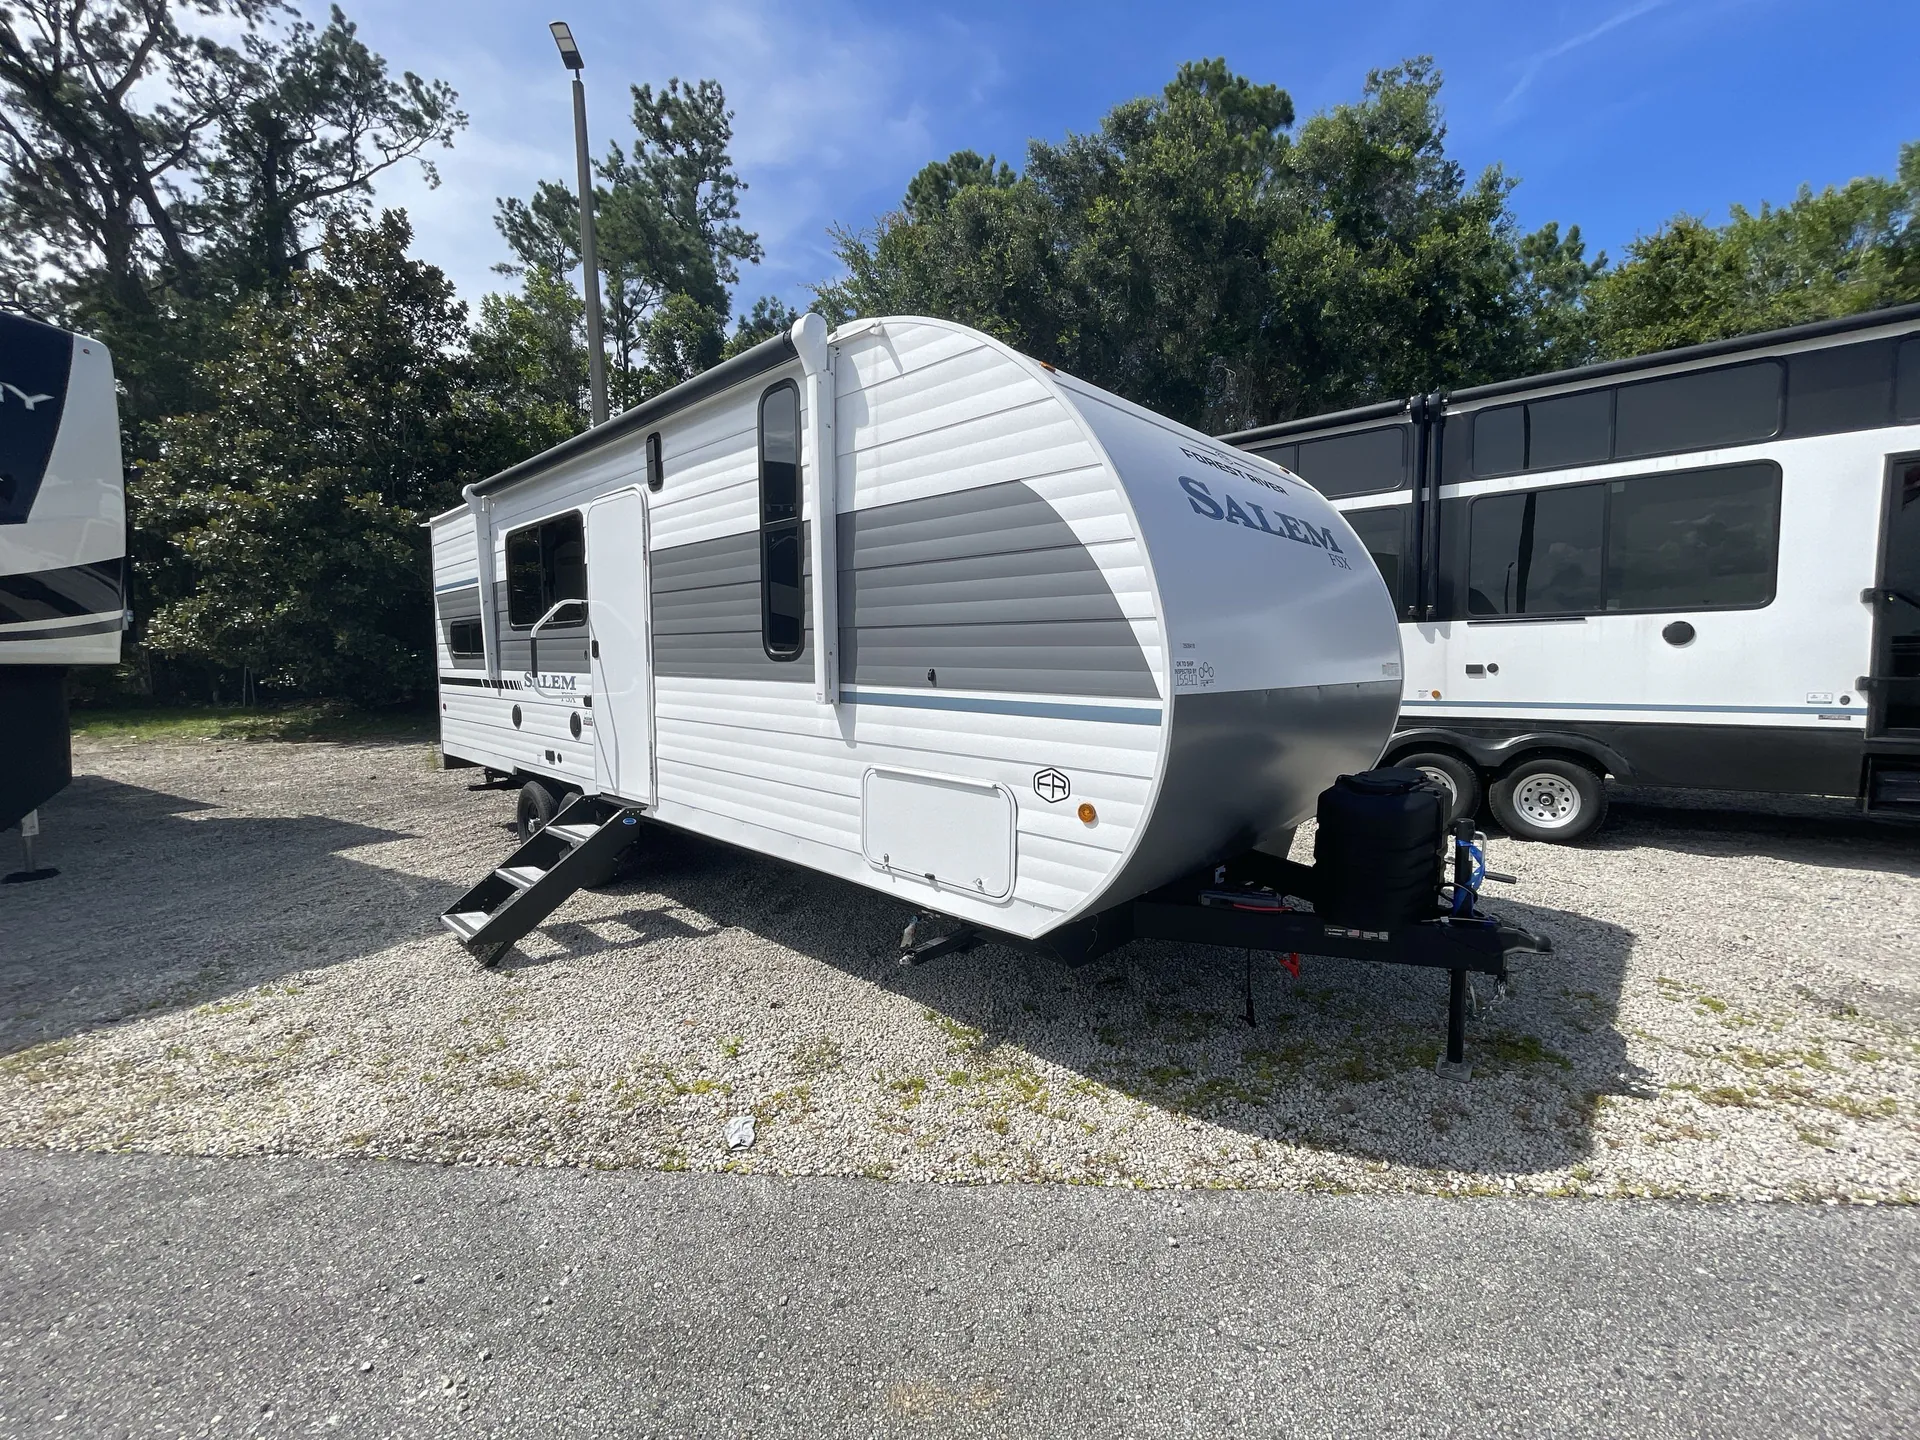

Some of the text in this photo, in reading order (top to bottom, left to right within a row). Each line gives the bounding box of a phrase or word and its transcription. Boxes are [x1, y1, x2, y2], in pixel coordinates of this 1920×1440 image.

[0, 381, 55, 411] Y
[1179, 446, 1290, 496] FOREST RIVER
[1178, 476, 1343, 553] SALEM
[1328, 553, 1352, 570] FSX
